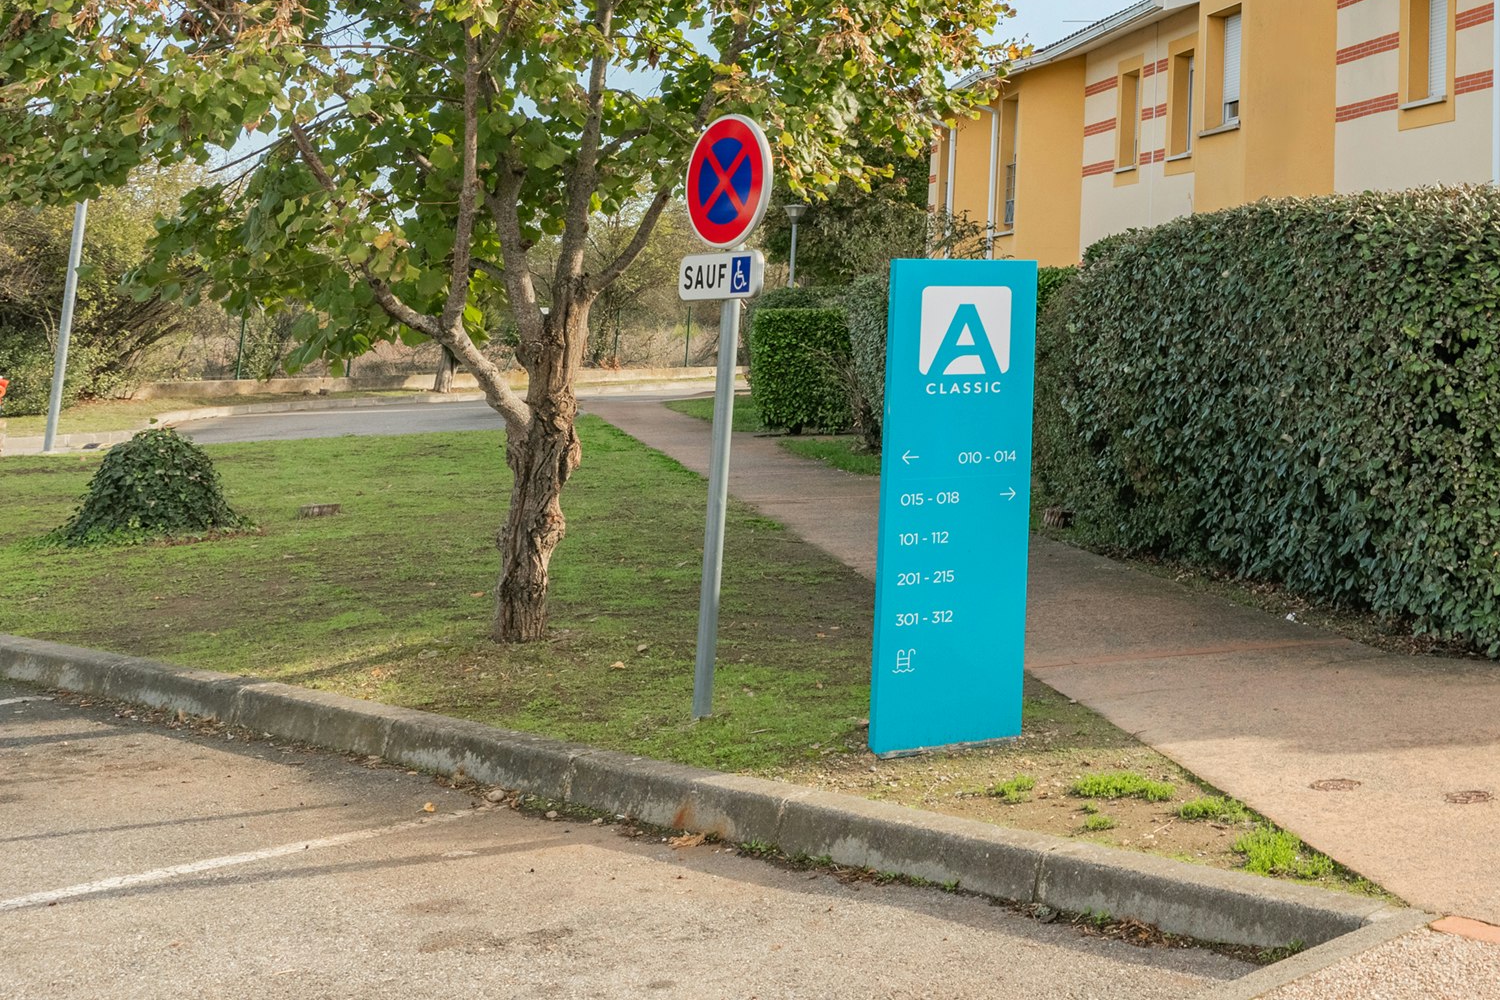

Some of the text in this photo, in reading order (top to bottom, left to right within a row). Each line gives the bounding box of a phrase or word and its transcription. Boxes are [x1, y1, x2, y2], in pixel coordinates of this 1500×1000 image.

[683, 263, 727, 291] SAUF
[926, 303, 1002, 376] A
[926, 381, 1001, 395] CLASSIC
[958, 451, 983, 465] 010
[993, 450, 1017, 463] 014
[900, 493, 924, 507] 015
[936, 491, 960, 505] 018
[899, 532, 919, 546] 101
[931, 531, 949, 544] 112
[896, 571, 921, 586] 201
[932, 569, 955, 584] 215
[895, 612, 919, 627] 301
[931, 609, 954, 624] 312
